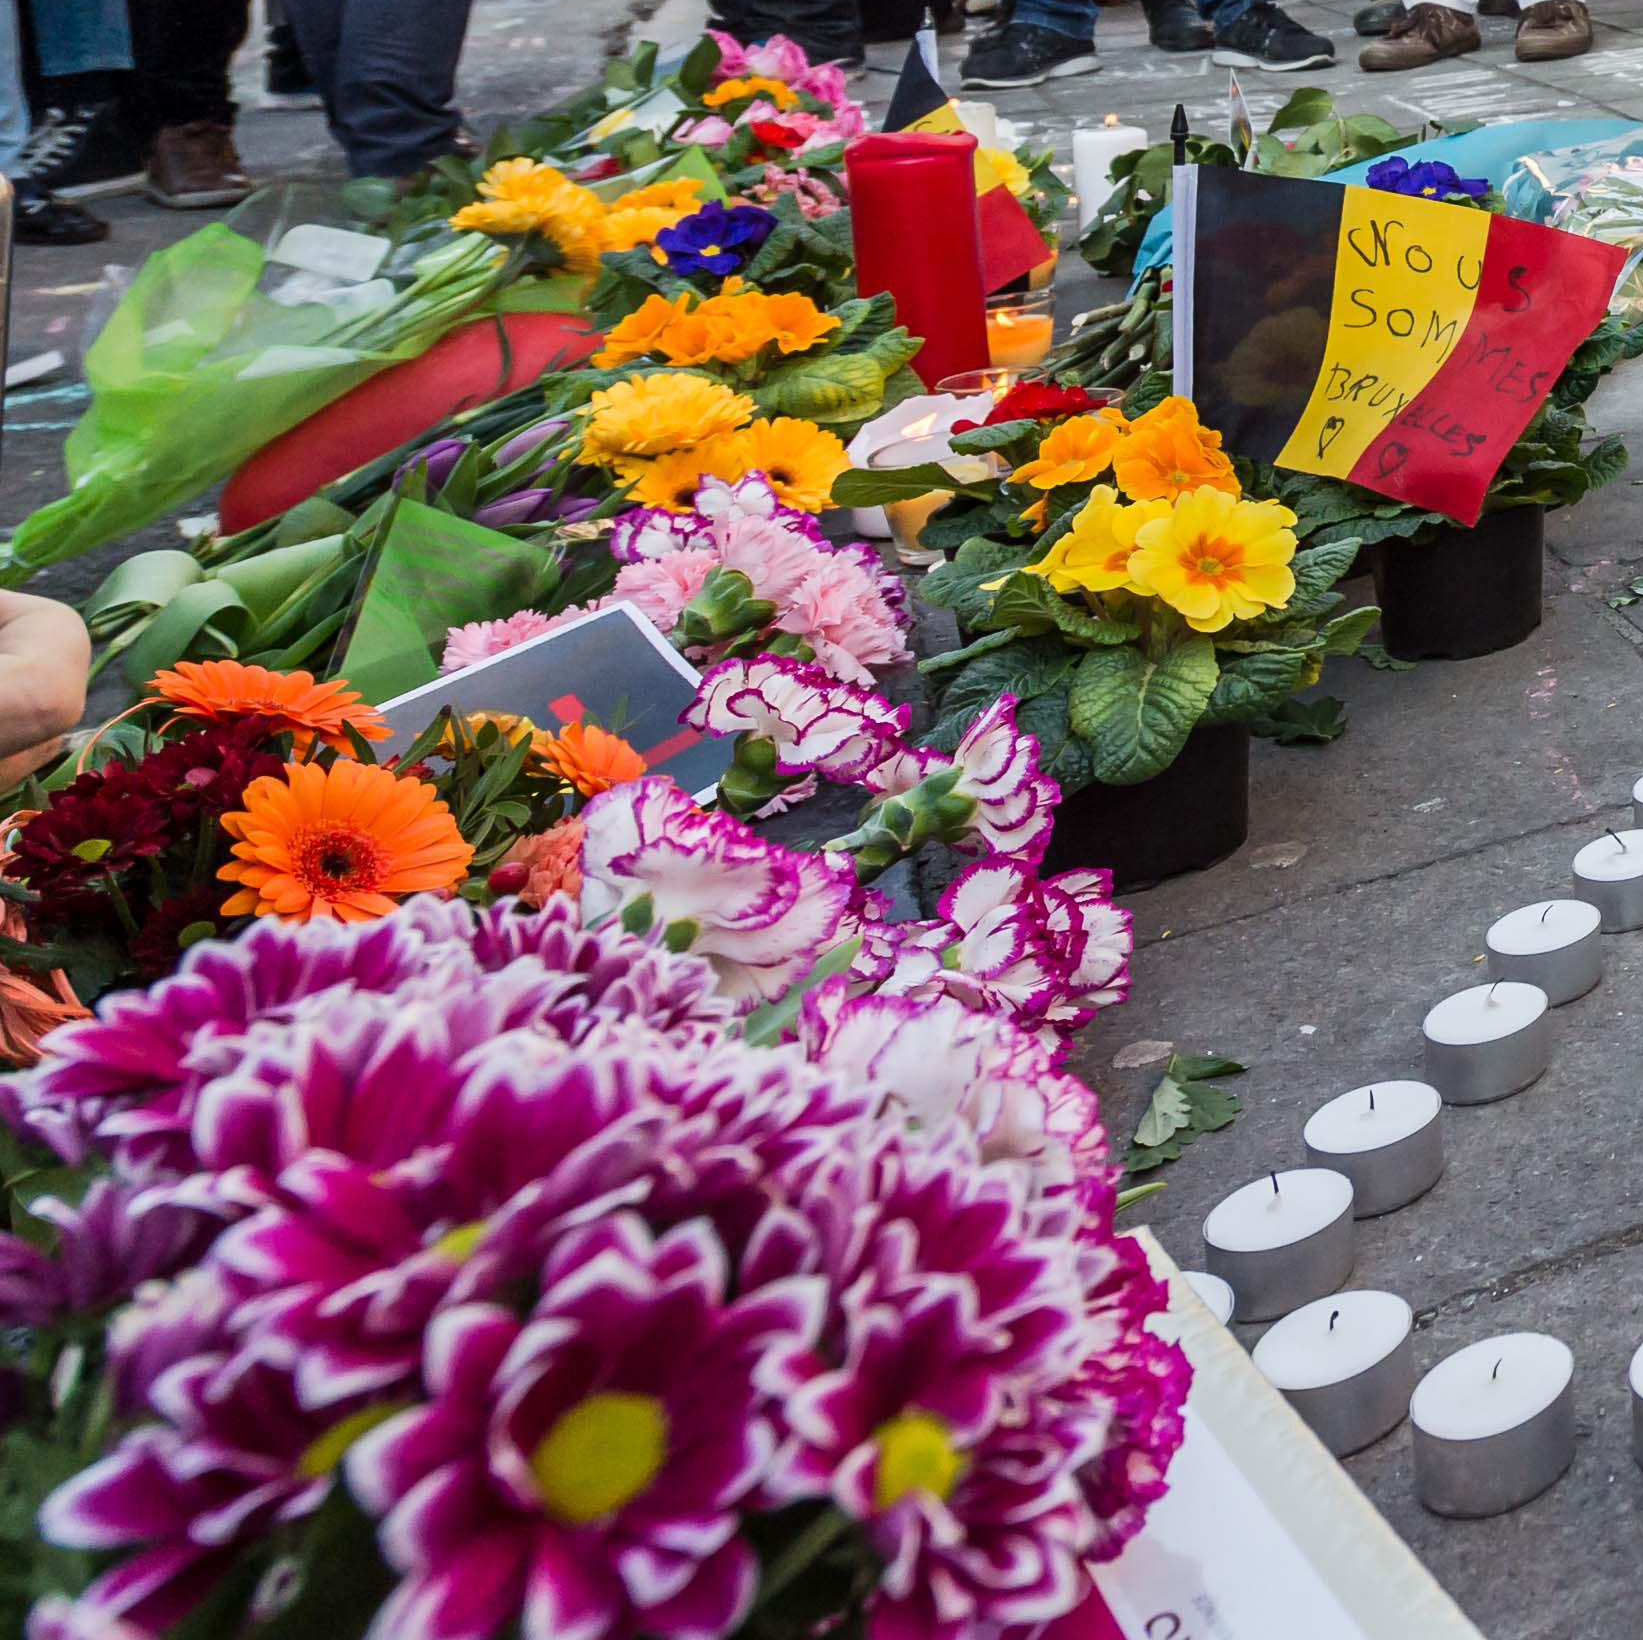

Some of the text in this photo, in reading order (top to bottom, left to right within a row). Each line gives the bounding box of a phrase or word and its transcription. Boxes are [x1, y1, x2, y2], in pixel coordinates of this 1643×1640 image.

[1348, 218, 1533, 313] NOUS
[1343, 288, 1550, 404] SOMMES
[1324, 365, 1487, 458] BRUXELLES
